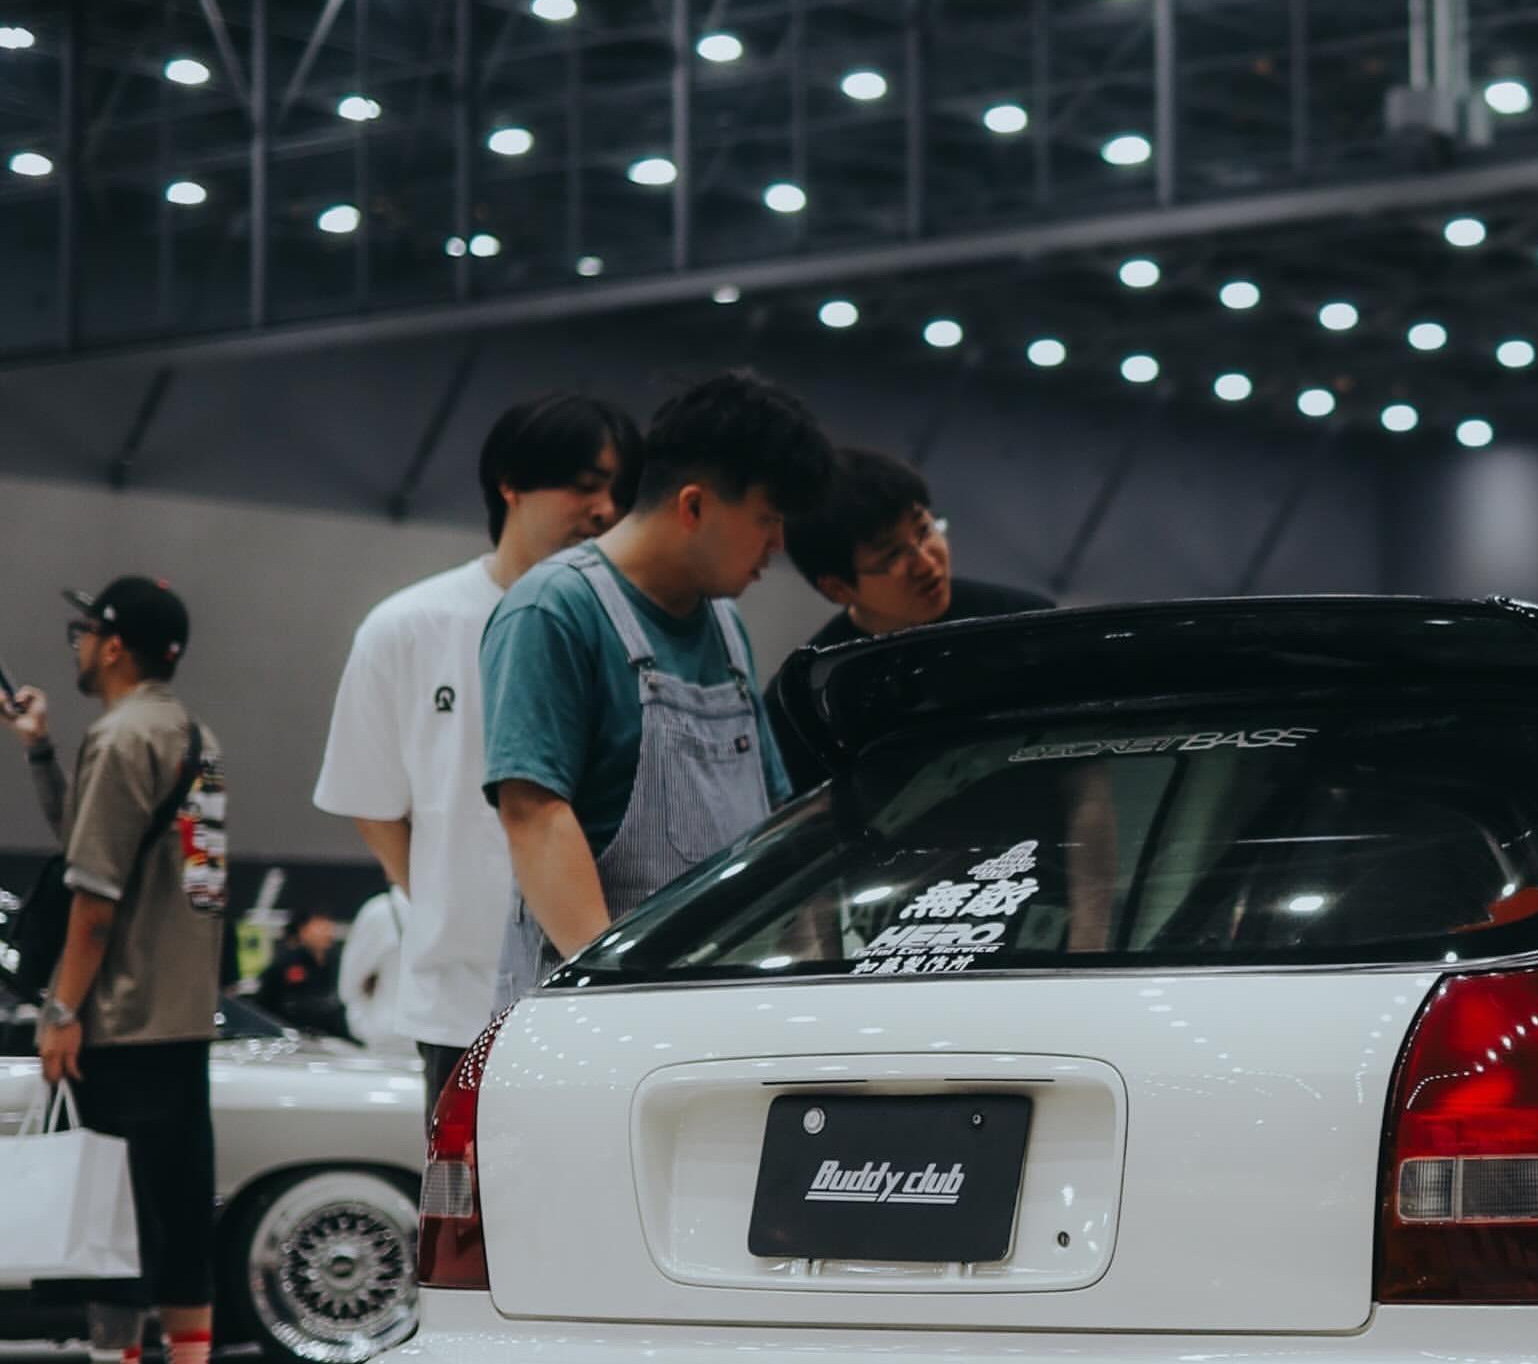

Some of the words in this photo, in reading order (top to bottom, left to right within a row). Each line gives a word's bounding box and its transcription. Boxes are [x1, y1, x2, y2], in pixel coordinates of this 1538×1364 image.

[867, 922, 1006, 948] HERO
[810, 1160, 903, 1202] Buddy
[902, 1163, 965, 1194] club
